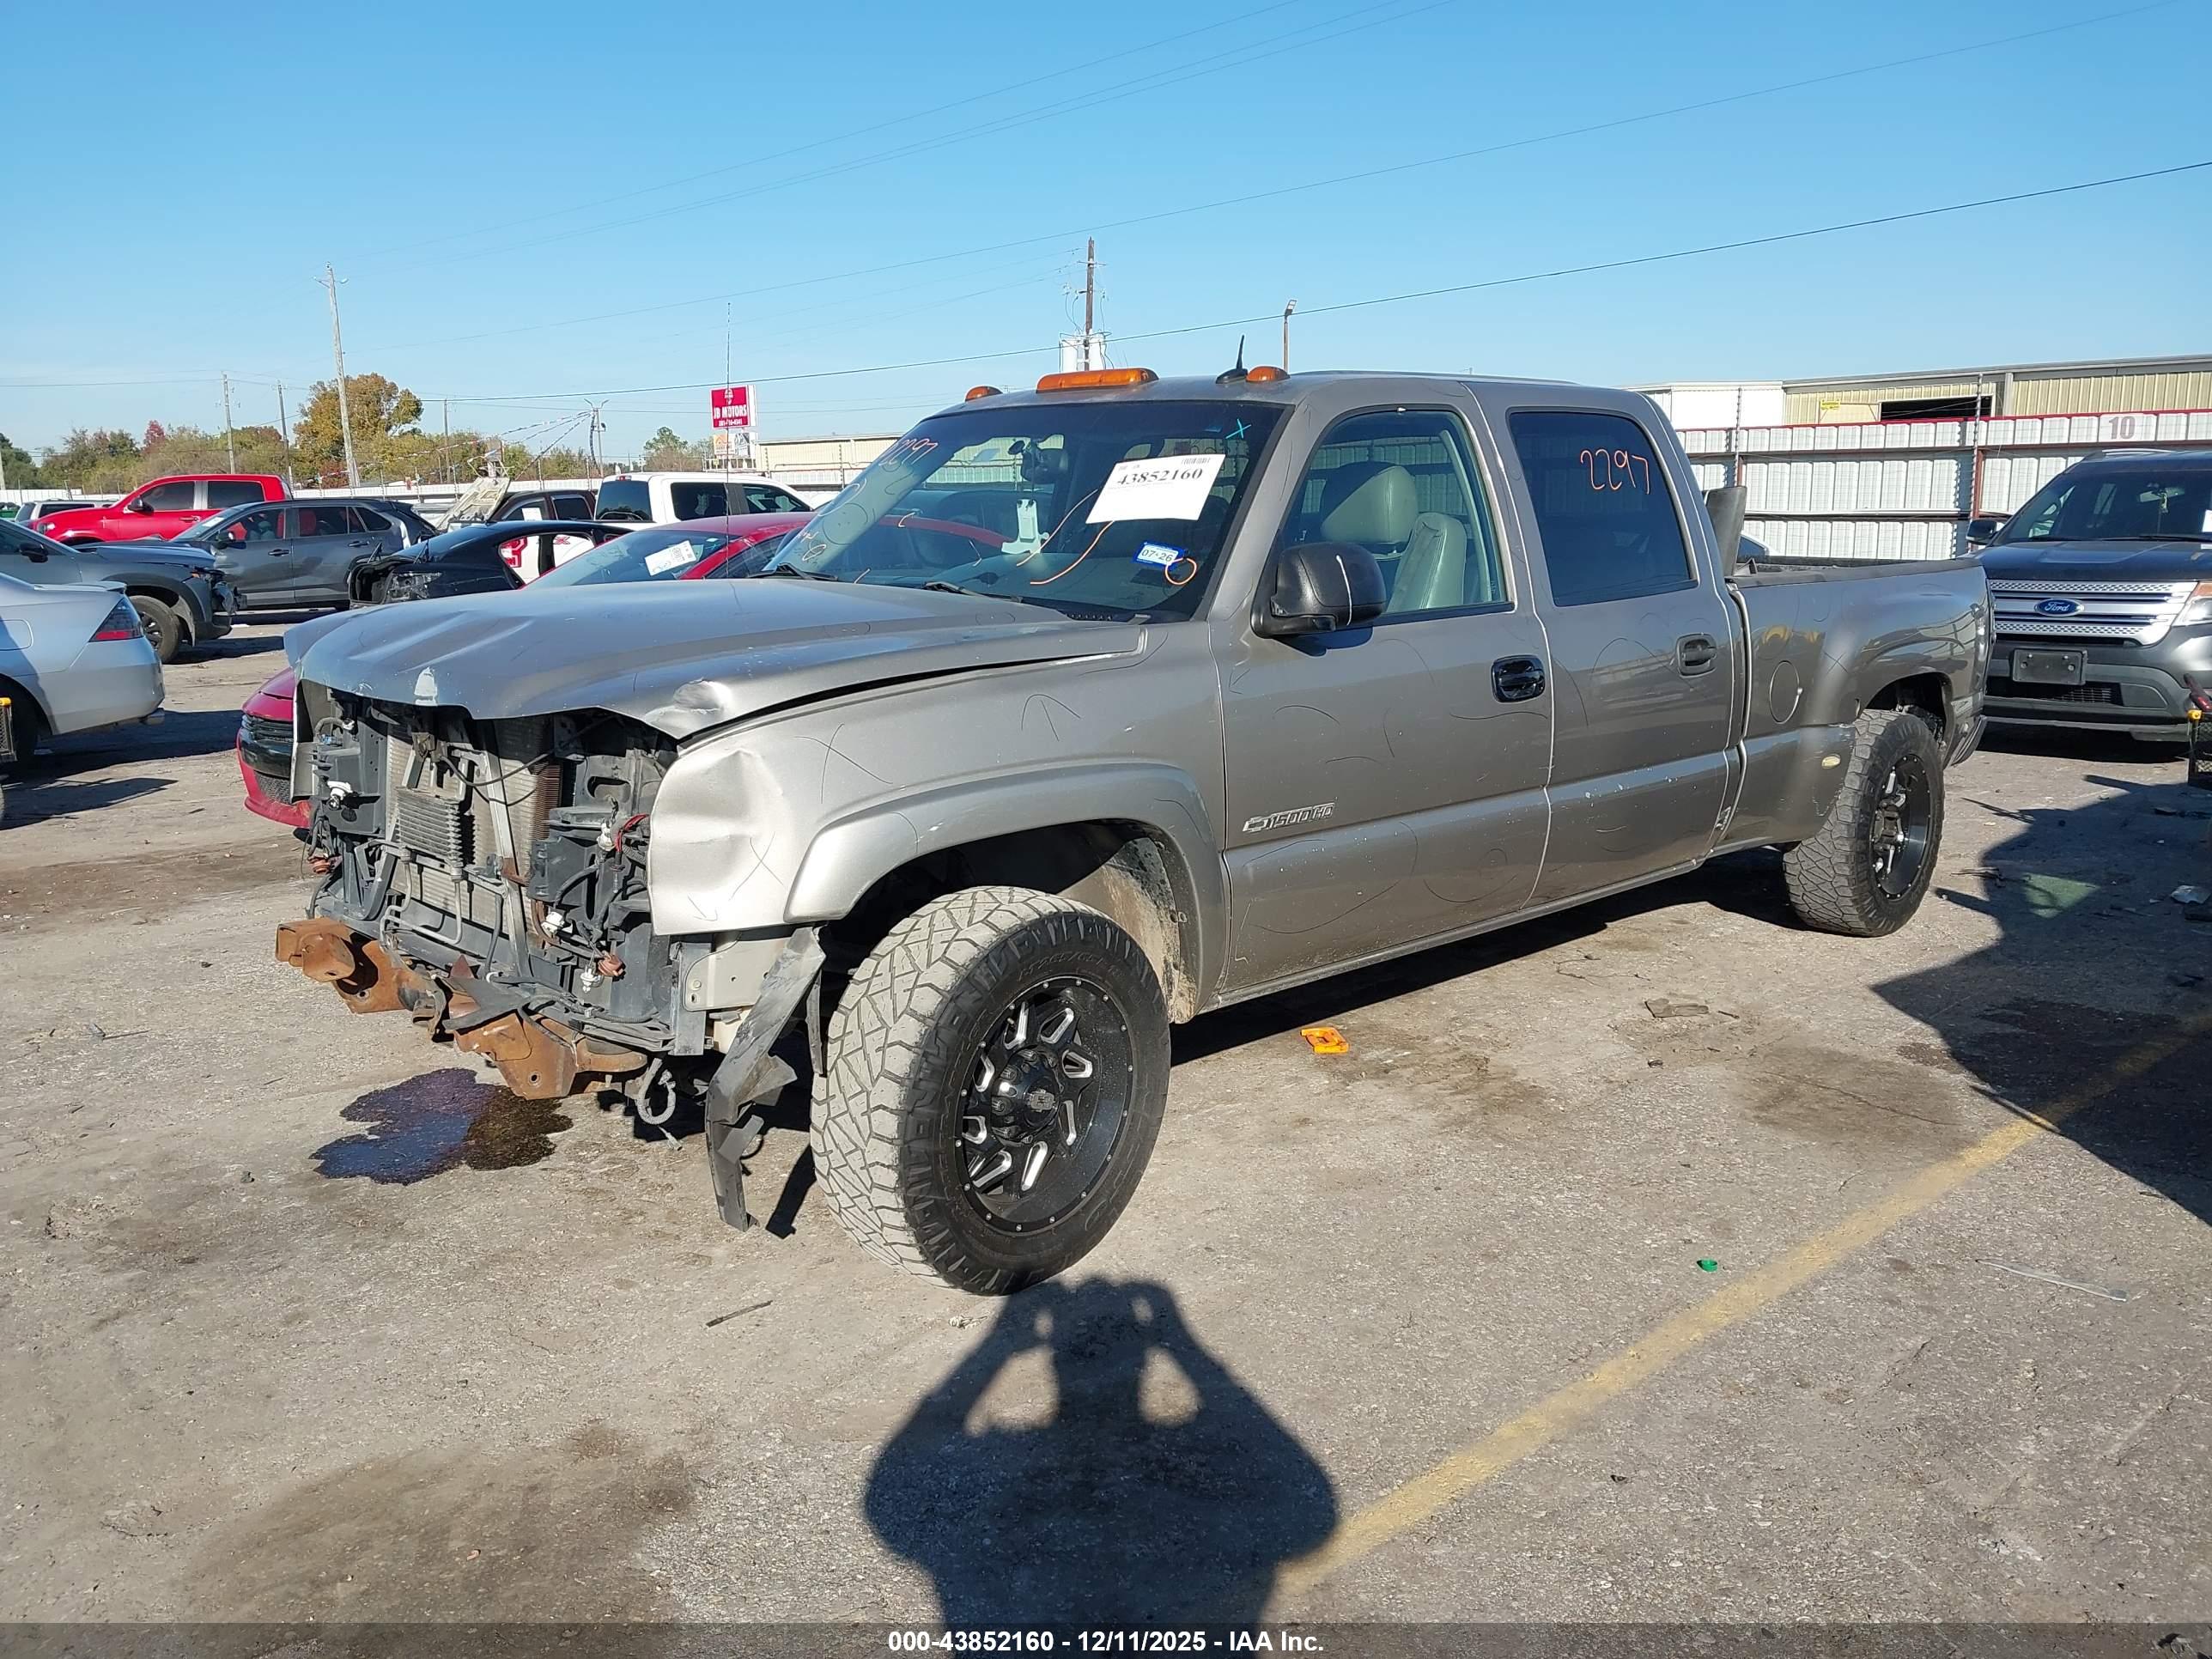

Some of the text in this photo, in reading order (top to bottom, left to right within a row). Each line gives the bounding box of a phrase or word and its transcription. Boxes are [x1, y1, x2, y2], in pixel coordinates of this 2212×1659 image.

[714, 404, 747, 419] JB MOTORS
[2109, 416, 2136, 440] 10
[1117, 468, 1203, 485] 43852160
[1579, 448, 1650, 495] 2297
[2044, 601, 2070, 612] Ford
[1269, 804, 1334, 829] 1500 HD
